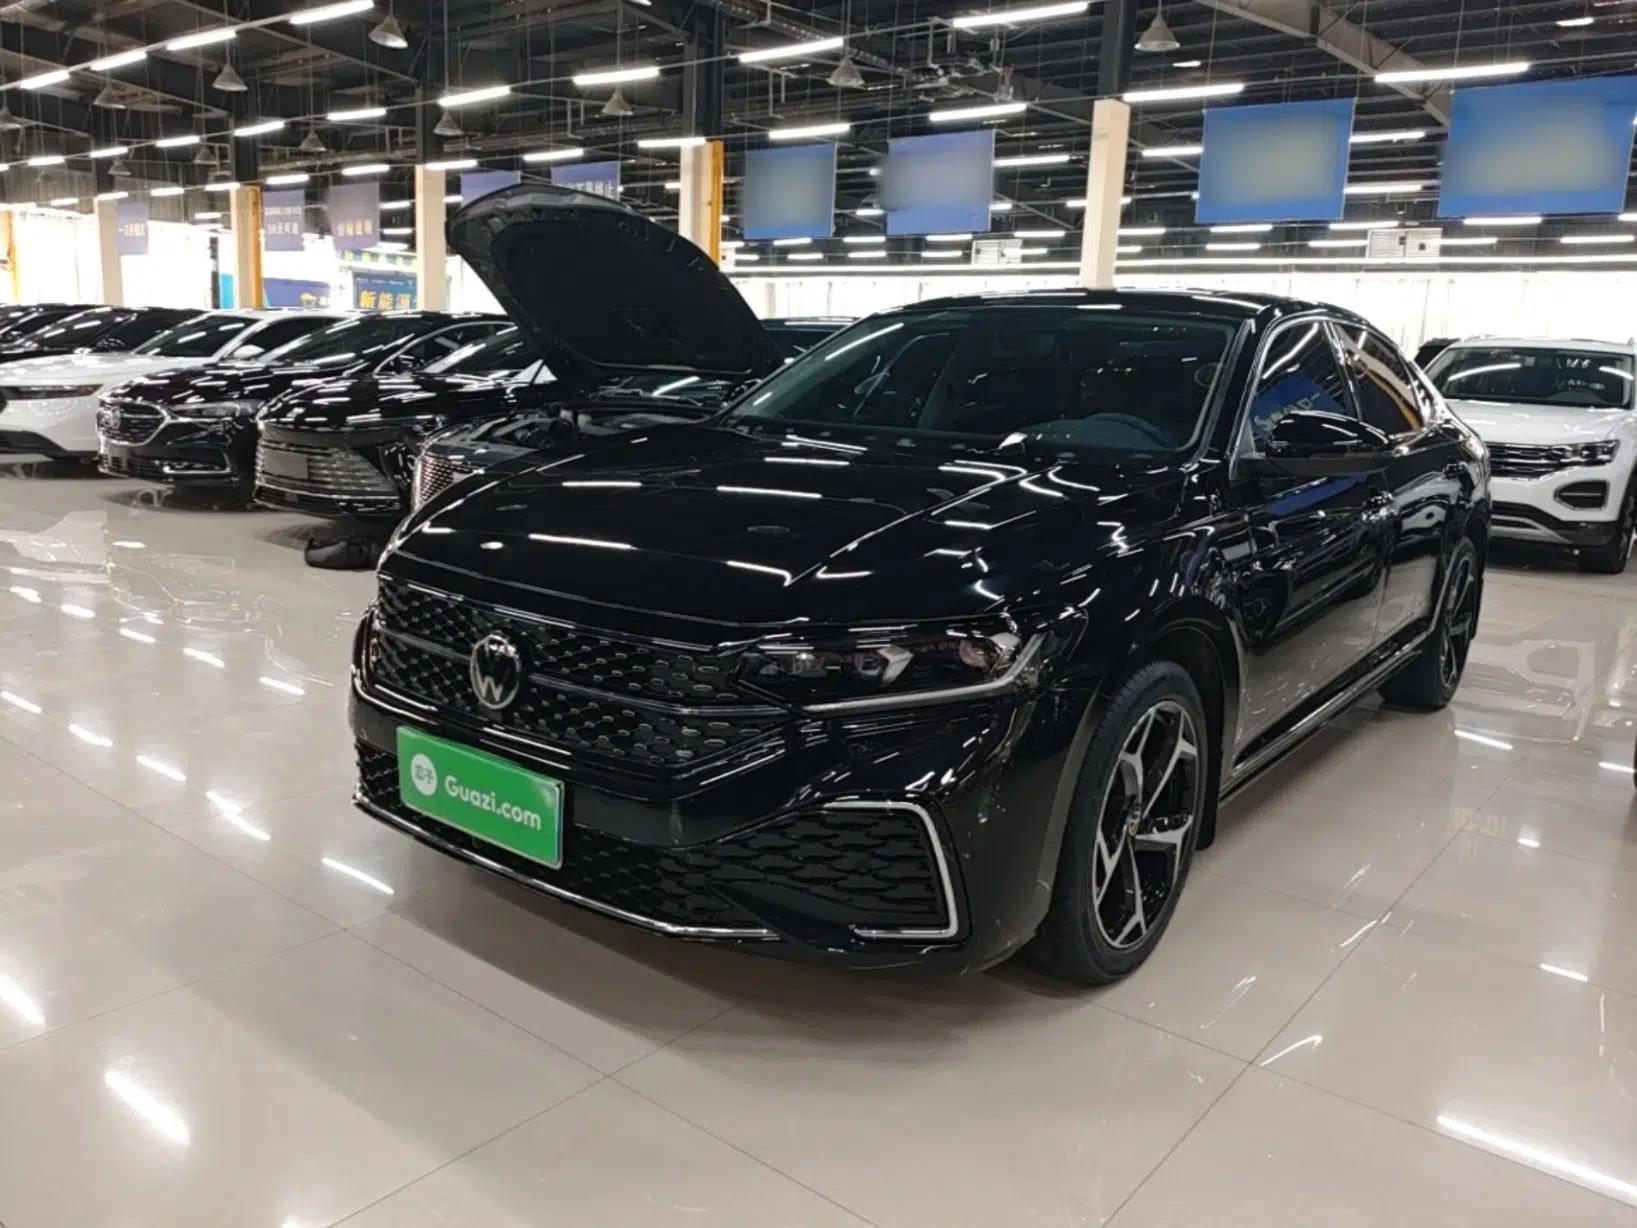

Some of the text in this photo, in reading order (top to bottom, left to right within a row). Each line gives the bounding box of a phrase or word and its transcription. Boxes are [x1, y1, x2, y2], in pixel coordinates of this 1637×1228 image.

[360, 290, 417, 311] 新能源
[444, 775, 542, 832] Guazi.com
